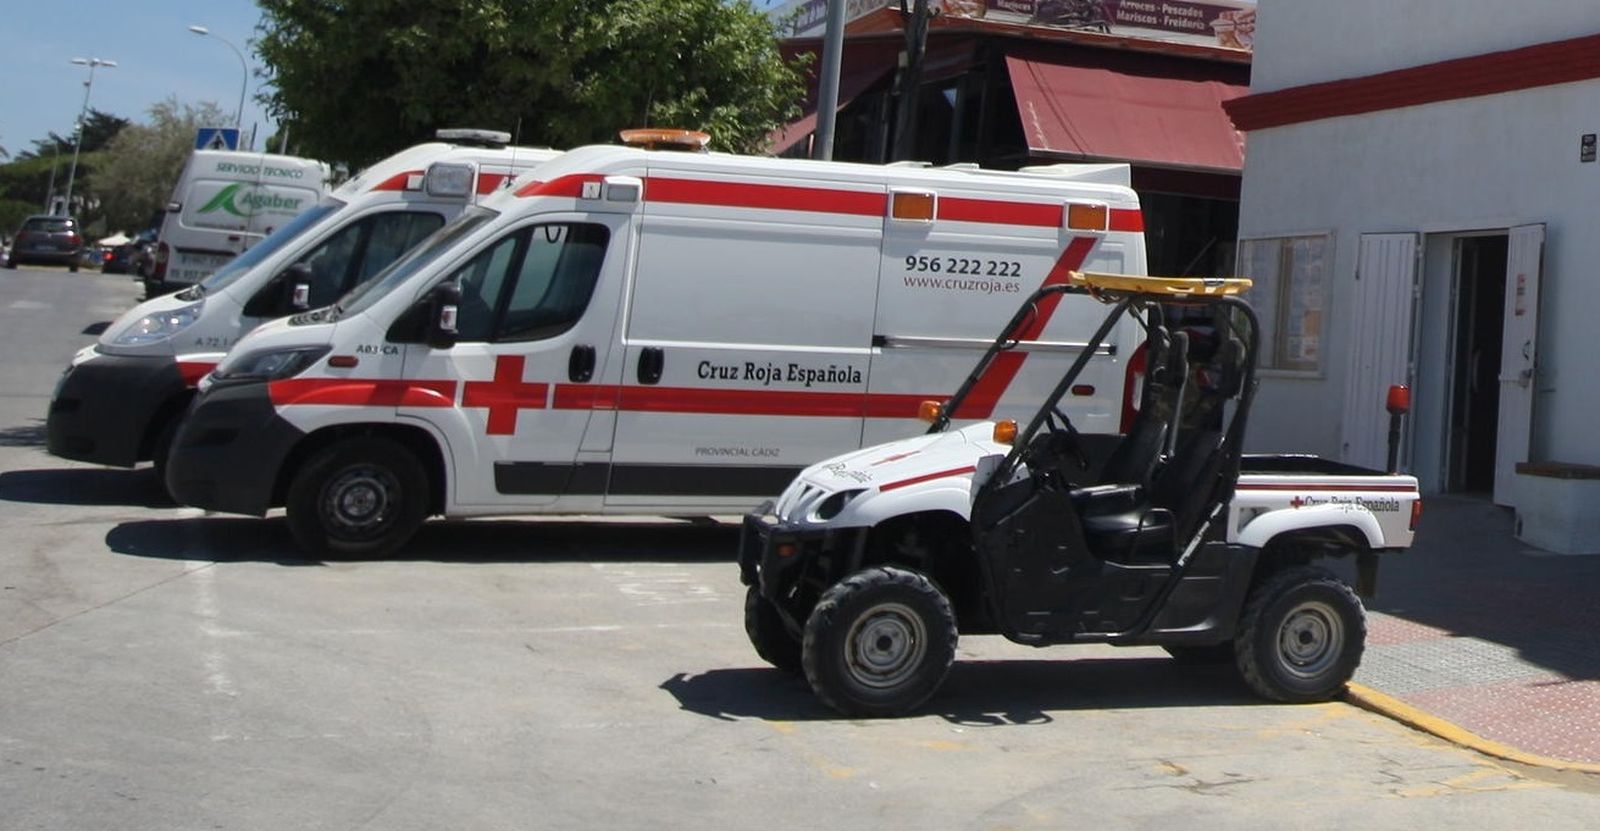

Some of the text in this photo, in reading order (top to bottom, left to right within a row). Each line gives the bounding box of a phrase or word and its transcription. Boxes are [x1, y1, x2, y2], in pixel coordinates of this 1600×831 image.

[1116, 9, 1158, 25] Mariscos
[241, 193, 302, 209] Agaber
[905, 255, 1021, 277] 956 222 222
[904, 277, 1020, 294] www.cruzroja.es
[698, 360, 862, 388] Cruz Roja Española
